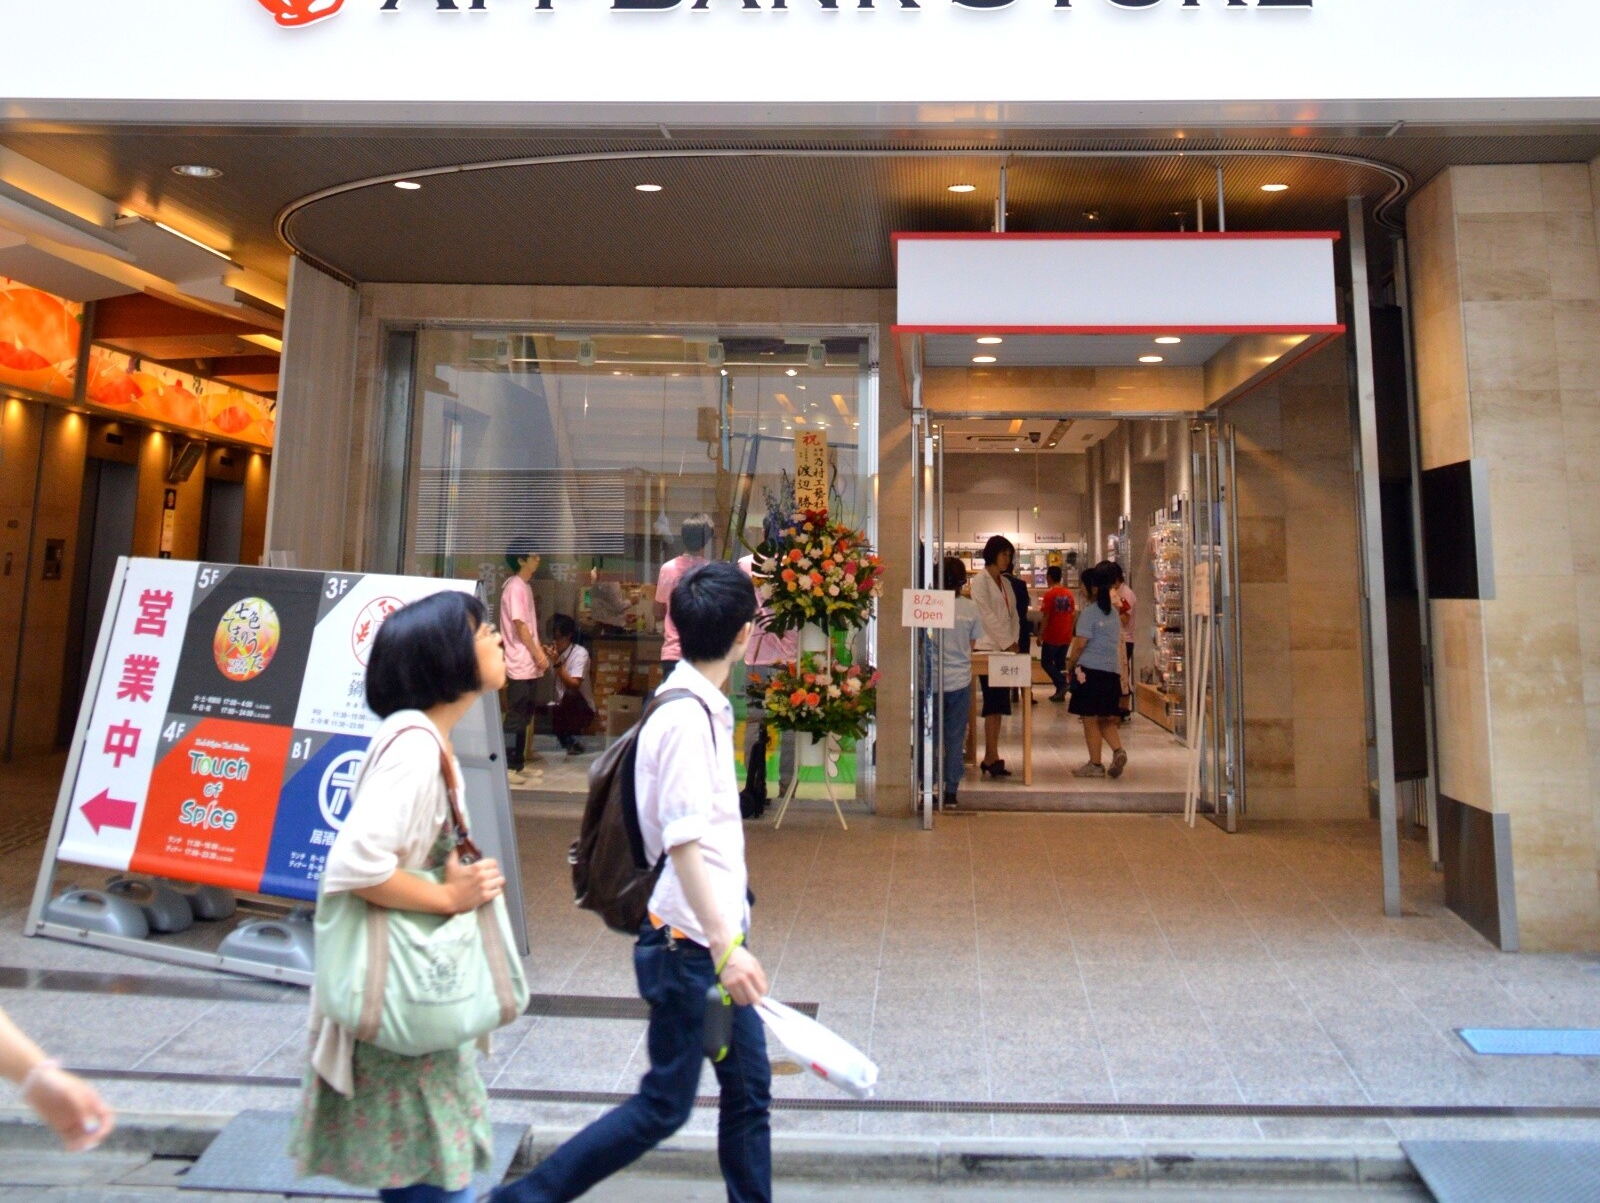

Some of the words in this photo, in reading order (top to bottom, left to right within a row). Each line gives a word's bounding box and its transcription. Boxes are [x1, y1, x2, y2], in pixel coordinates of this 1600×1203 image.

[198, 568, 219, 588] 5F
[325, 577, 348, 599] 3F
[913, 608, 943, 621] Open
[103, 589, 174, 768] 営業中
[1000, 665, 1019, 676] 受付
[163, 720, 186, 742] 4F
[291, 737, 312, 760] B1
[188, 750, 250, 781] Touch
[203, 781, 224, 798] of
[179, 799, 237, 831] Spice
